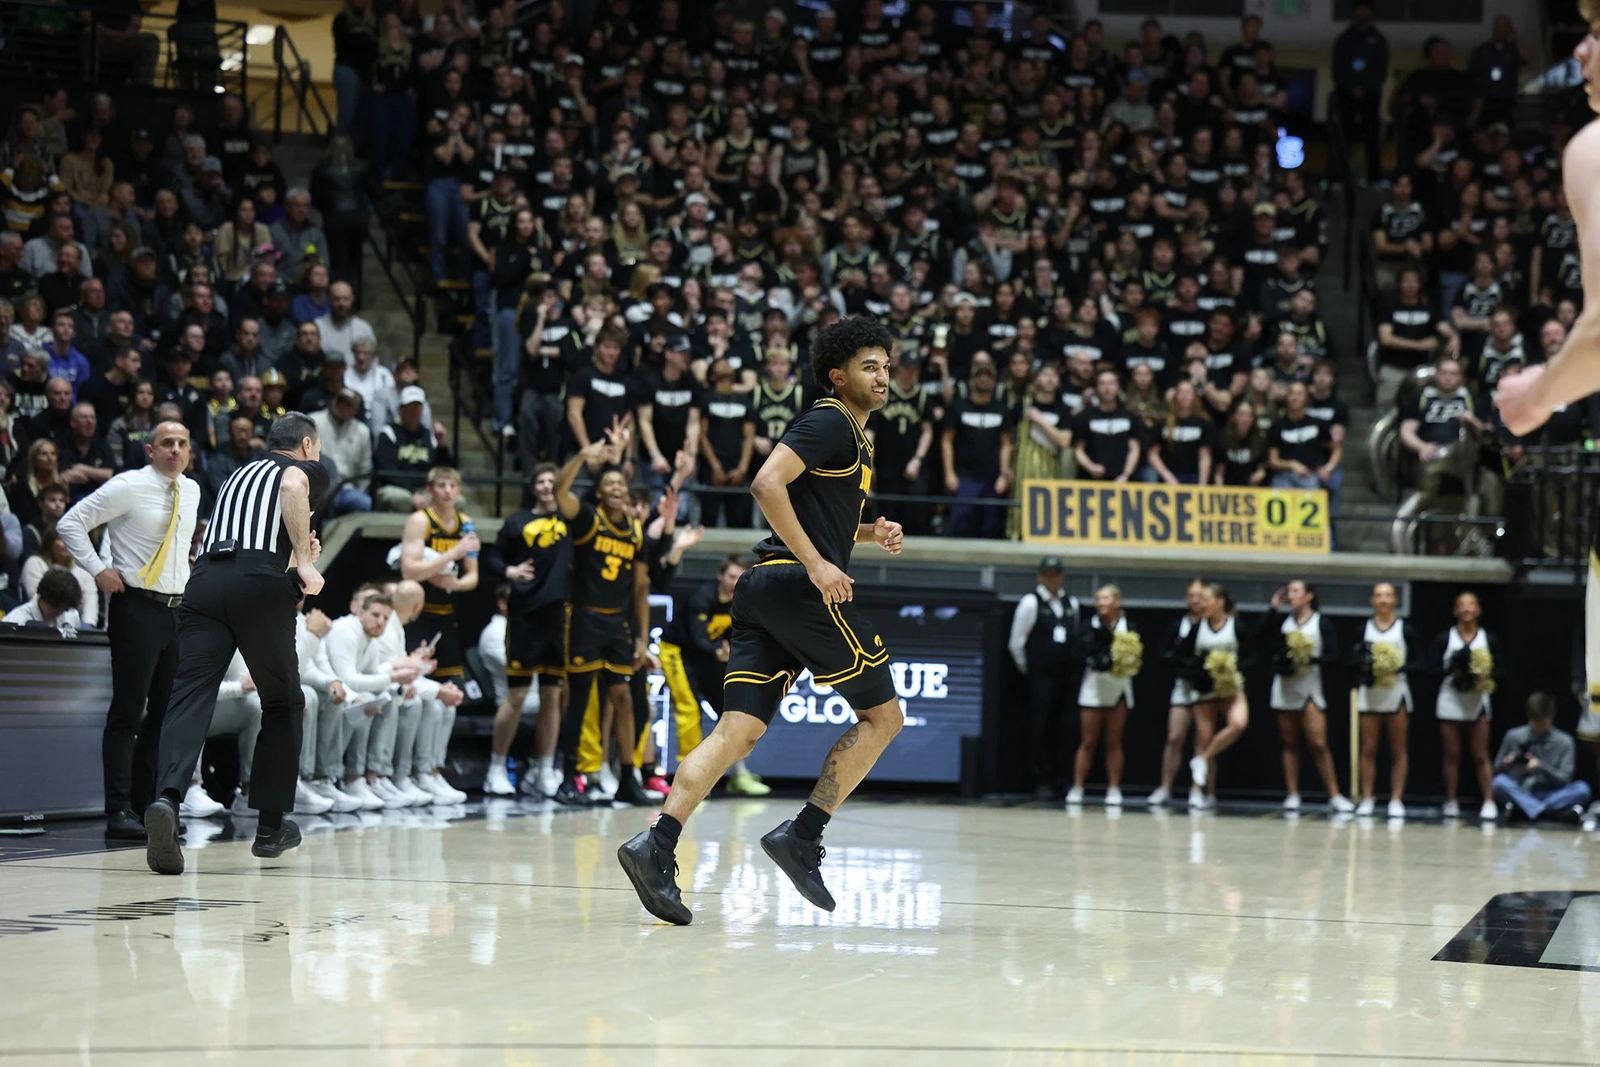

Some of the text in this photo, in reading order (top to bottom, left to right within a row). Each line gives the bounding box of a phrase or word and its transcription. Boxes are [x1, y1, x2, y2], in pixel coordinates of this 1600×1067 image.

[1029, 486, 1193, 542] DEFENSE
[1199, 493, 1256, 517] LIVES
[1266, 498, 1320, 529] 0 2
[1200, 521, 1257, 545] HERE
[594, 535, 635, 560] IOWA
[601, 555, 623, 582] 3
[779, 694, 918, 725] GLOL
